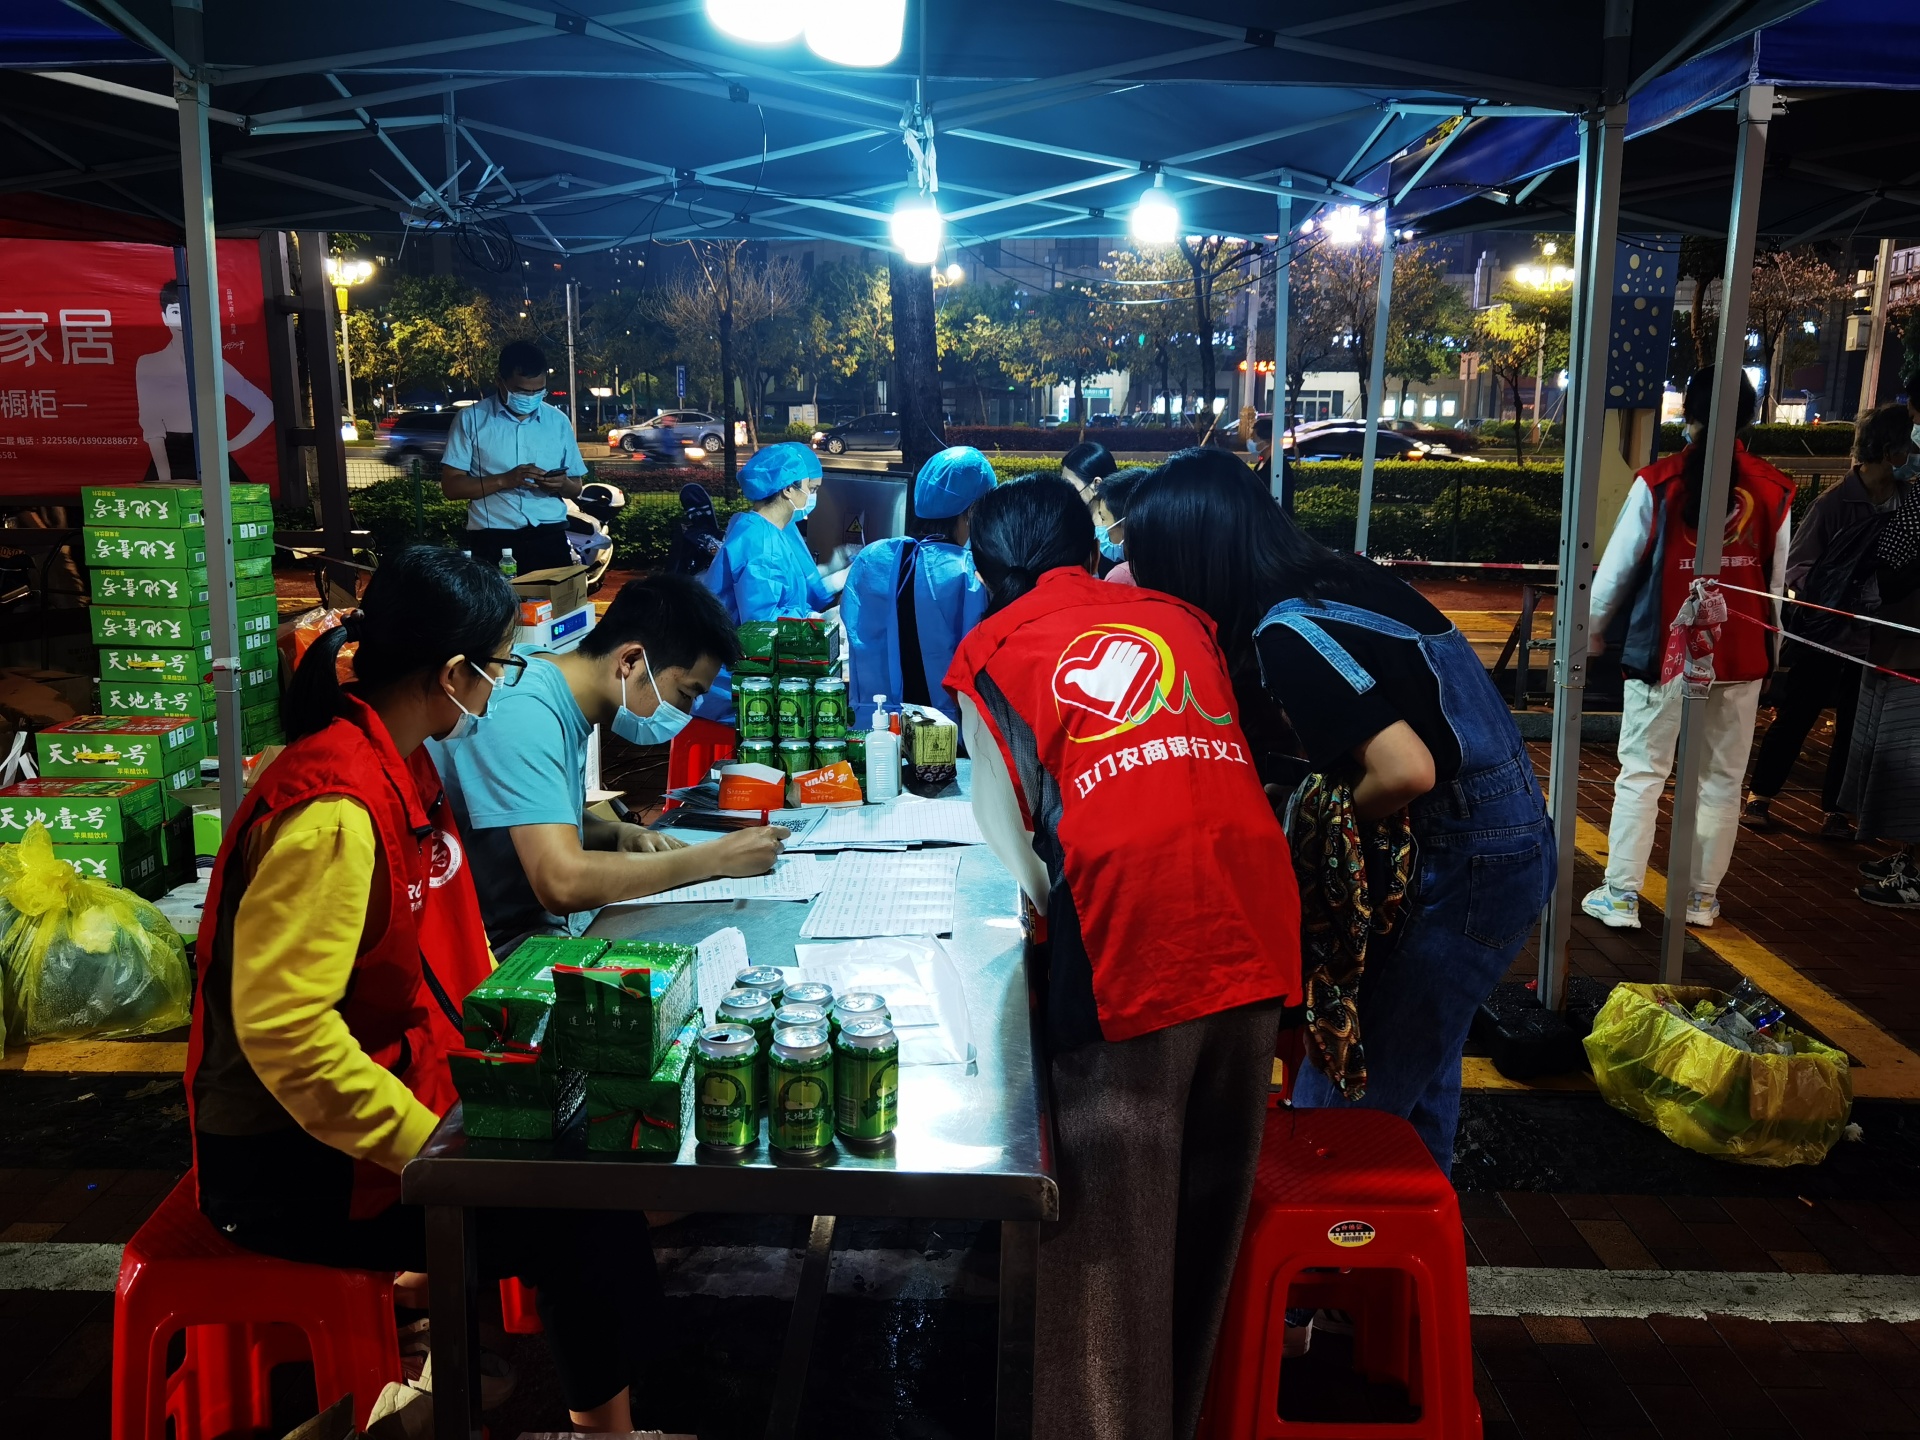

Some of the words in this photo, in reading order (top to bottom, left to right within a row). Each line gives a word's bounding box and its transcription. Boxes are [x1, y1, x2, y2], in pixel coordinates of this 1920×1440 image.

[0, 309, 114, 367] 家居
[0, 390, 58, 418] 橱柜
[93, 499, 169, 520] 天地壹号
[95, 539, 176, 560] 天地壹号
[101, 577, 179, 599] 天地壹号
[102, 618, 182, 639] 天地壹号
[109, 690, 190, 712] 天地壹号
[1074, 736, 1248, 799] 江门农商银行义工
[0, 807, 107, 830] 天地壹号
